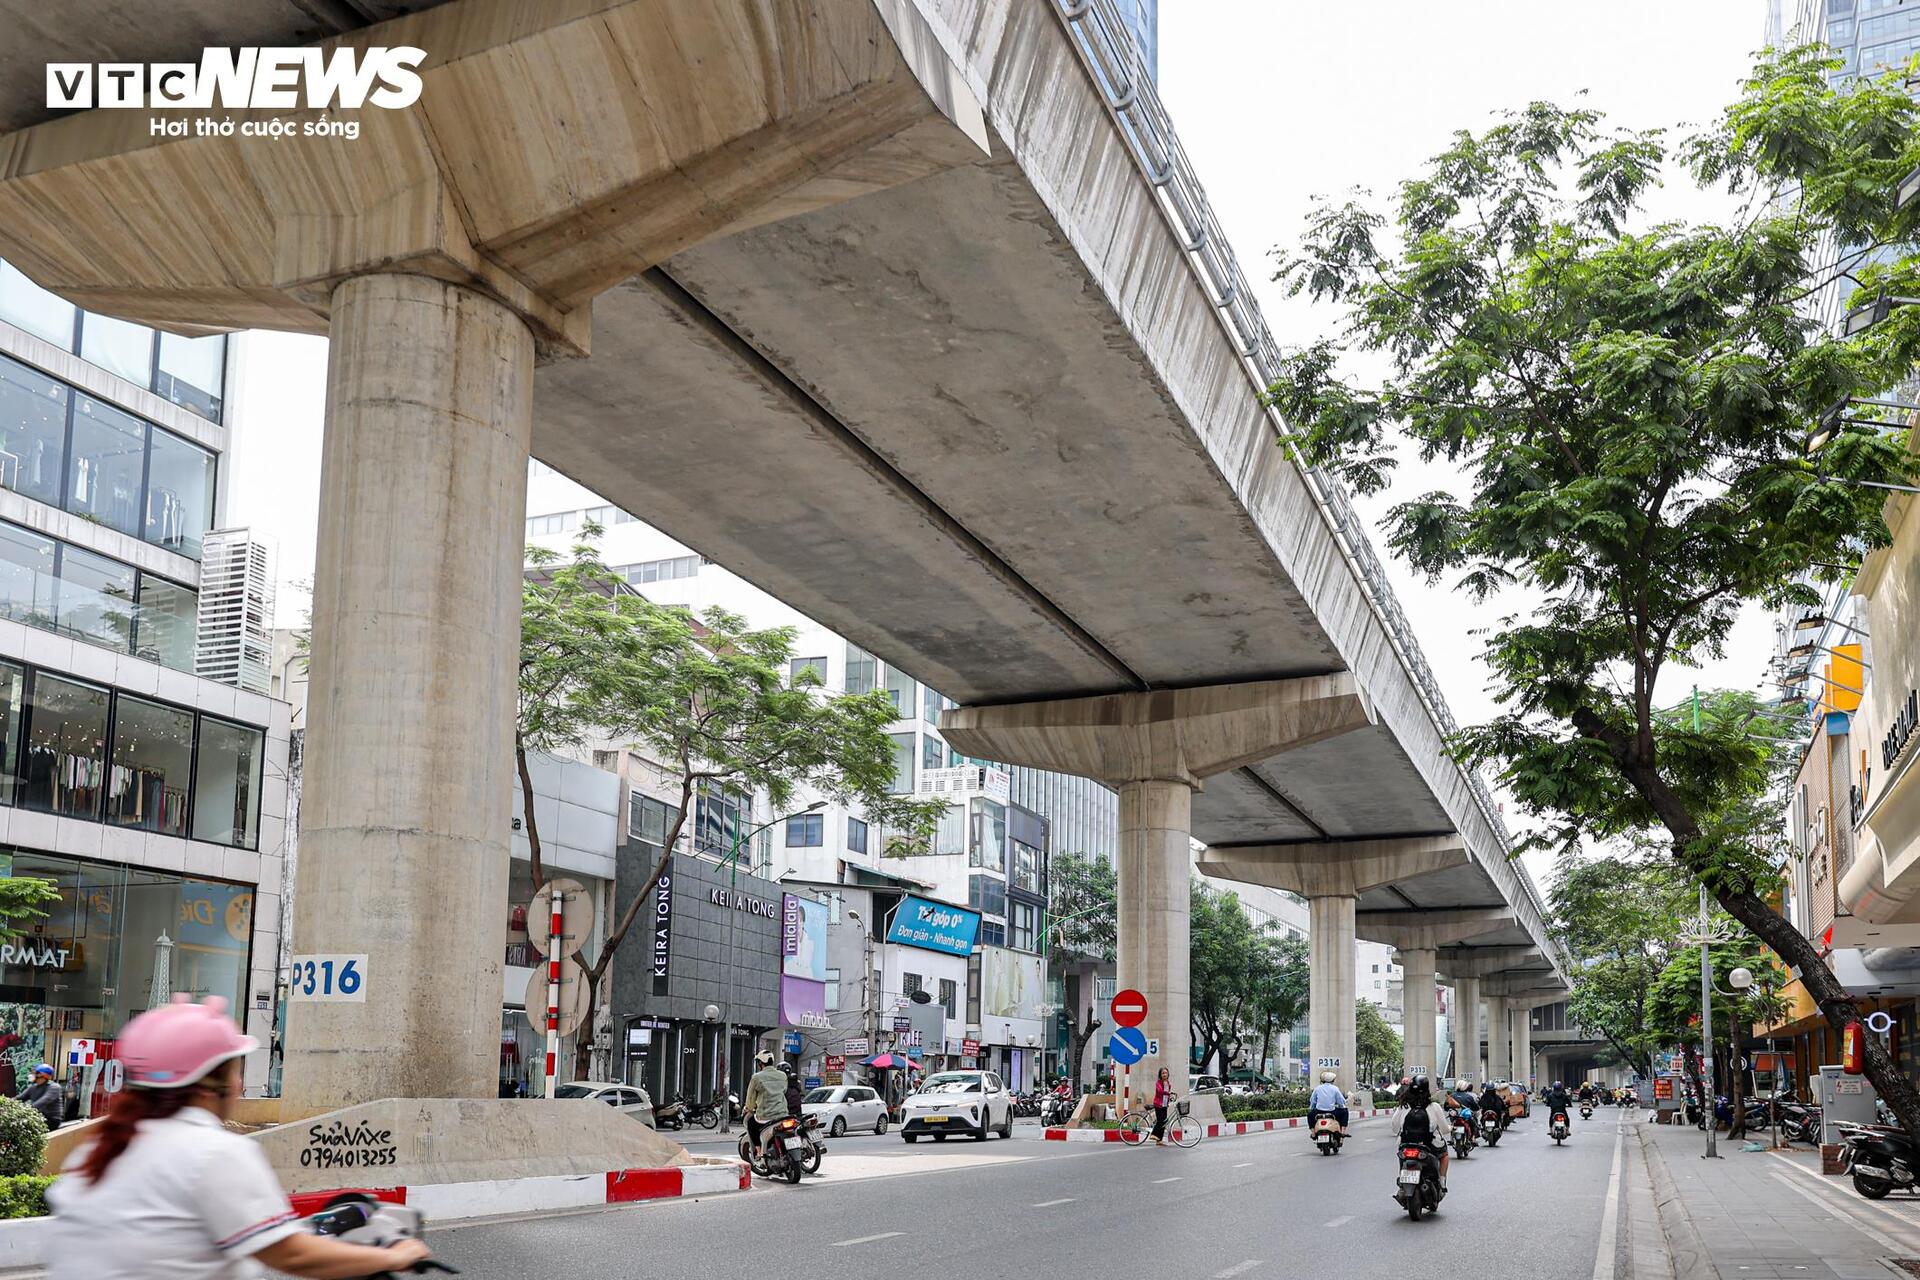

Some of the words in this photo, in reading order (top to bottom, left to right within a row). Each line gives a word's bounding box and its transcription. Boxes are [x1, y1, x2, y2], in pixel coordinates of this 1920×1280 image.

[657, 876, 670, 922] TONG
[746, 897, 775, 918] TONG
[931, 910, 950, 928] góp
[897, 925, 912, 939] Đơn
[933, 932, 955, 946] Nhanh
[955, 940, 968, 950] gọn
[0, 943, 69, 968] RMAT
[654, 929, 668, 976] KEIRA
[292, 960, 361, 996] P316
[1318, 1058, 1340, 1067] P314
[301, 1147, 397, 1168] 0794013255
